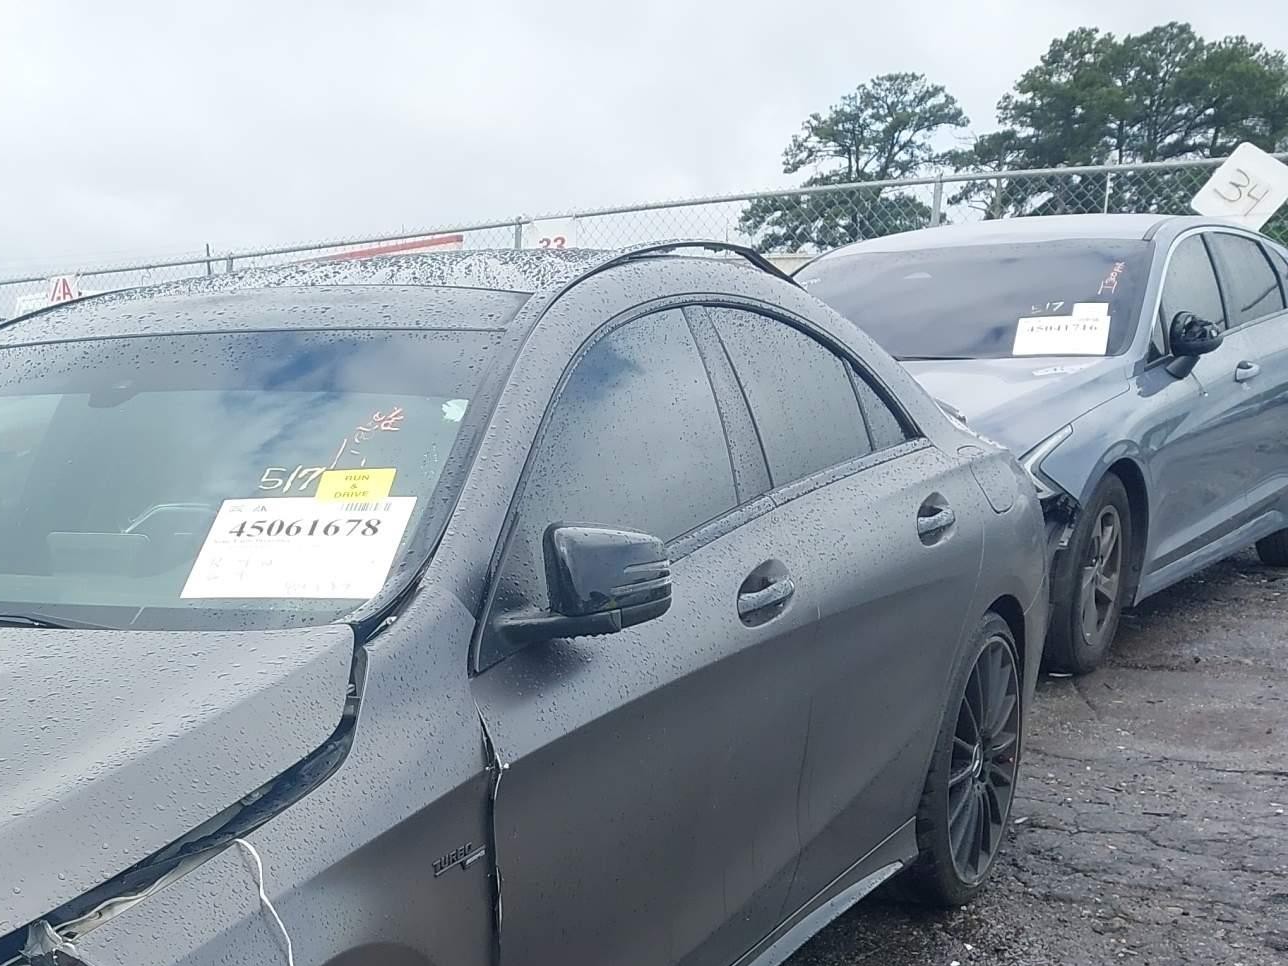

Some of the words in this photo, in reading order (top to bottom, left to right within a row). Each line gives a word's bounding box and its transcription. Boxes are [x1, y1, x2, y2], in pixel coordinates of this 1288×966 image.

[1213, 168, 1270, 217] 34
[344, 474, 370, 482] RUN
[333, 490, 369, 499] DRIVE
[227, 518, 382, 538] 45061678
